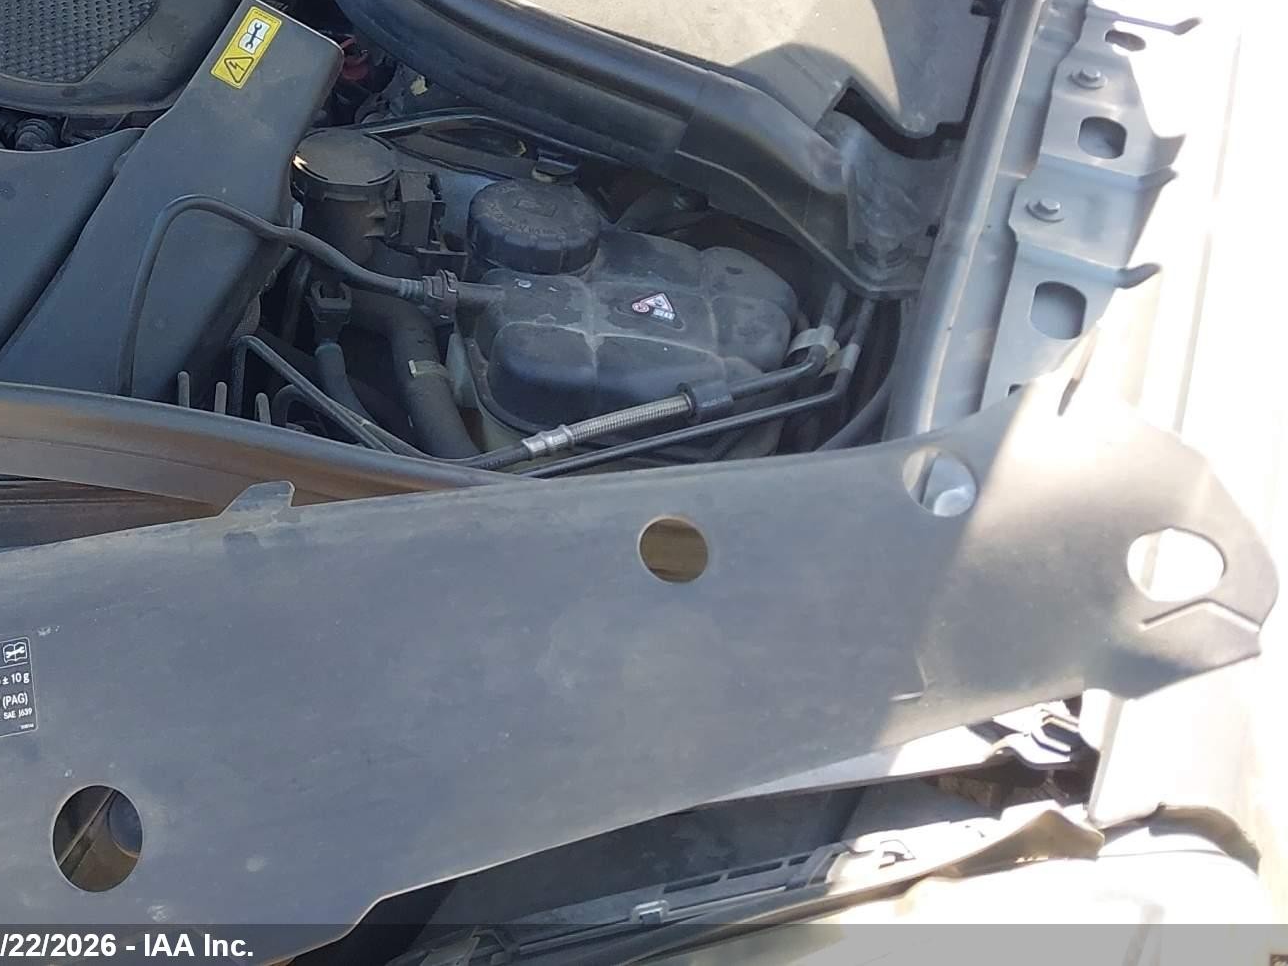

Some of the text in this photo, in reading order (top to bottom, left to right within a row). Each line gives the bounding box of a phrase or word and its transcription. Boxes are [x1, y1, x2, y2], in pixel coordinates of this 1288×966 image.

[12, 673, 21, 684] 10
[23, 672, 30, 684] g
[2, 692, 28, 709] (PAG)
[3, 709, 16, 720] SAE
